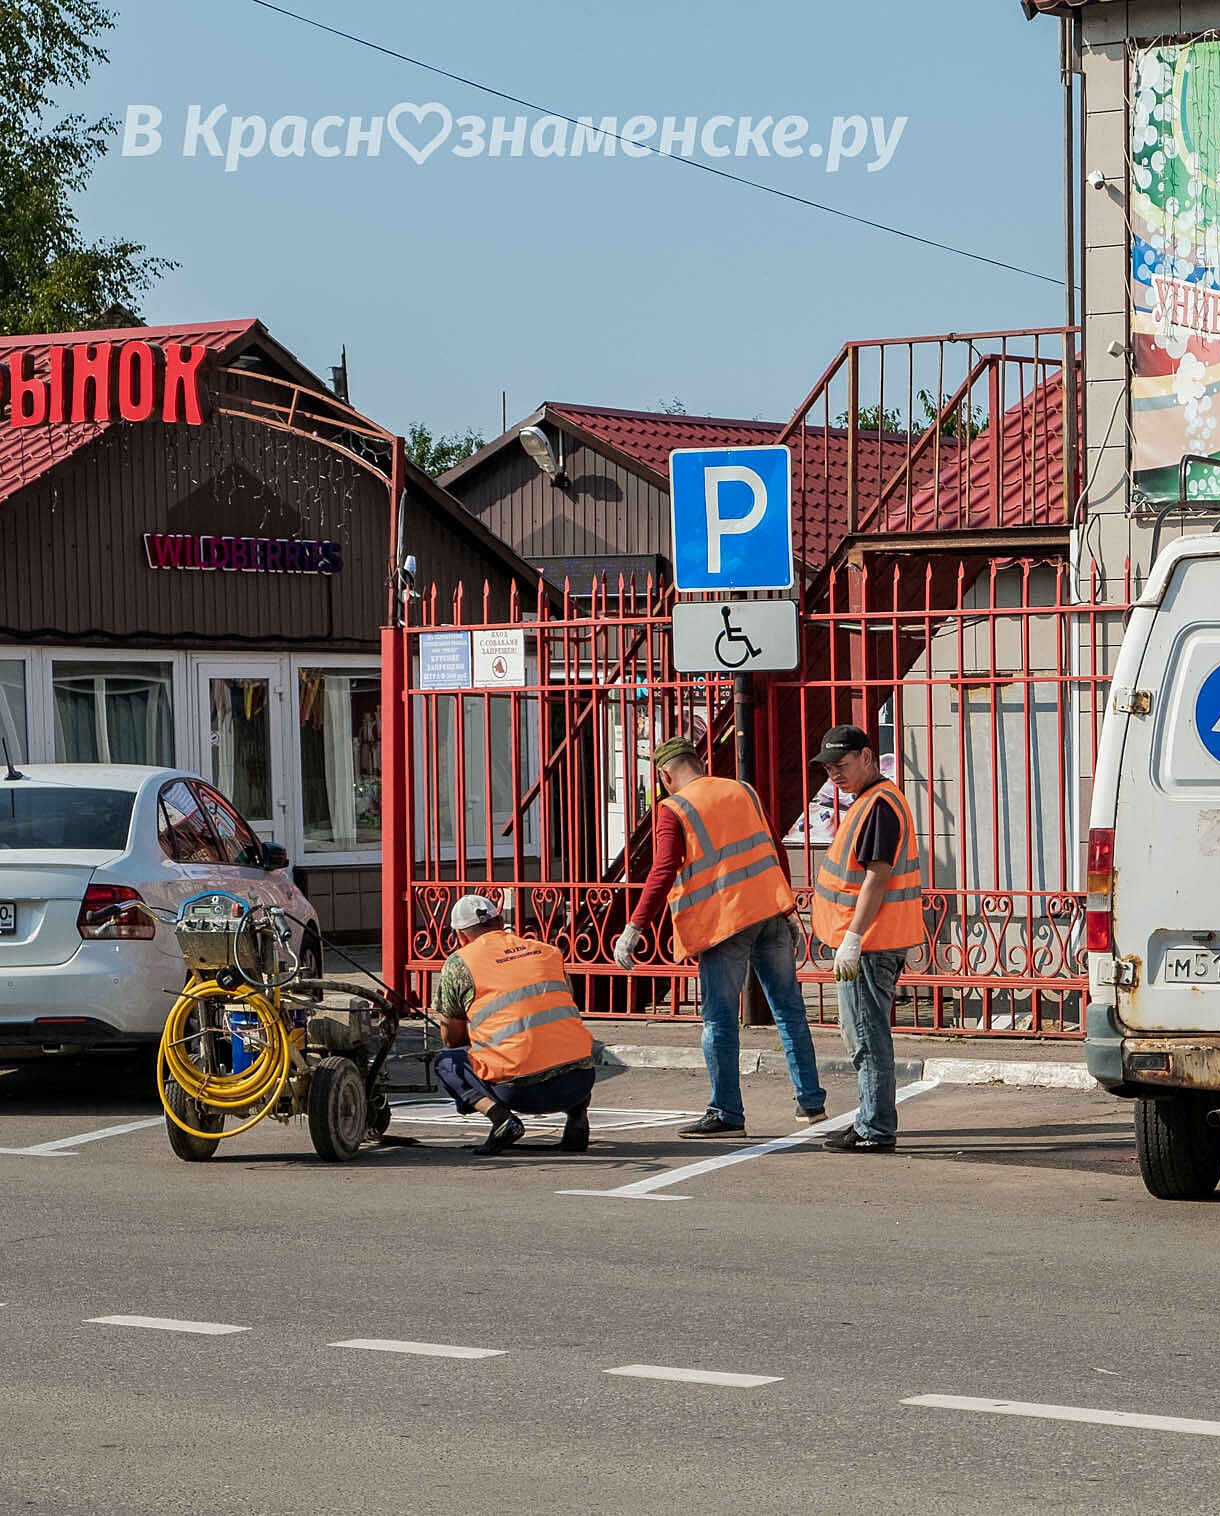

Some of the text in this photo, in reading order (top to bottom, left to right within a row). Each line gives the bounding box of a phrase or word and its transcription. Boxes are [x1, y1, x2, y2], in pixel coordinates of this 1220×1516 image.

[0, 340, 206, 428] ЫНОК
[144, 533, 344, 576] WILDBERRIES
[704, 465, 768, 574] P
